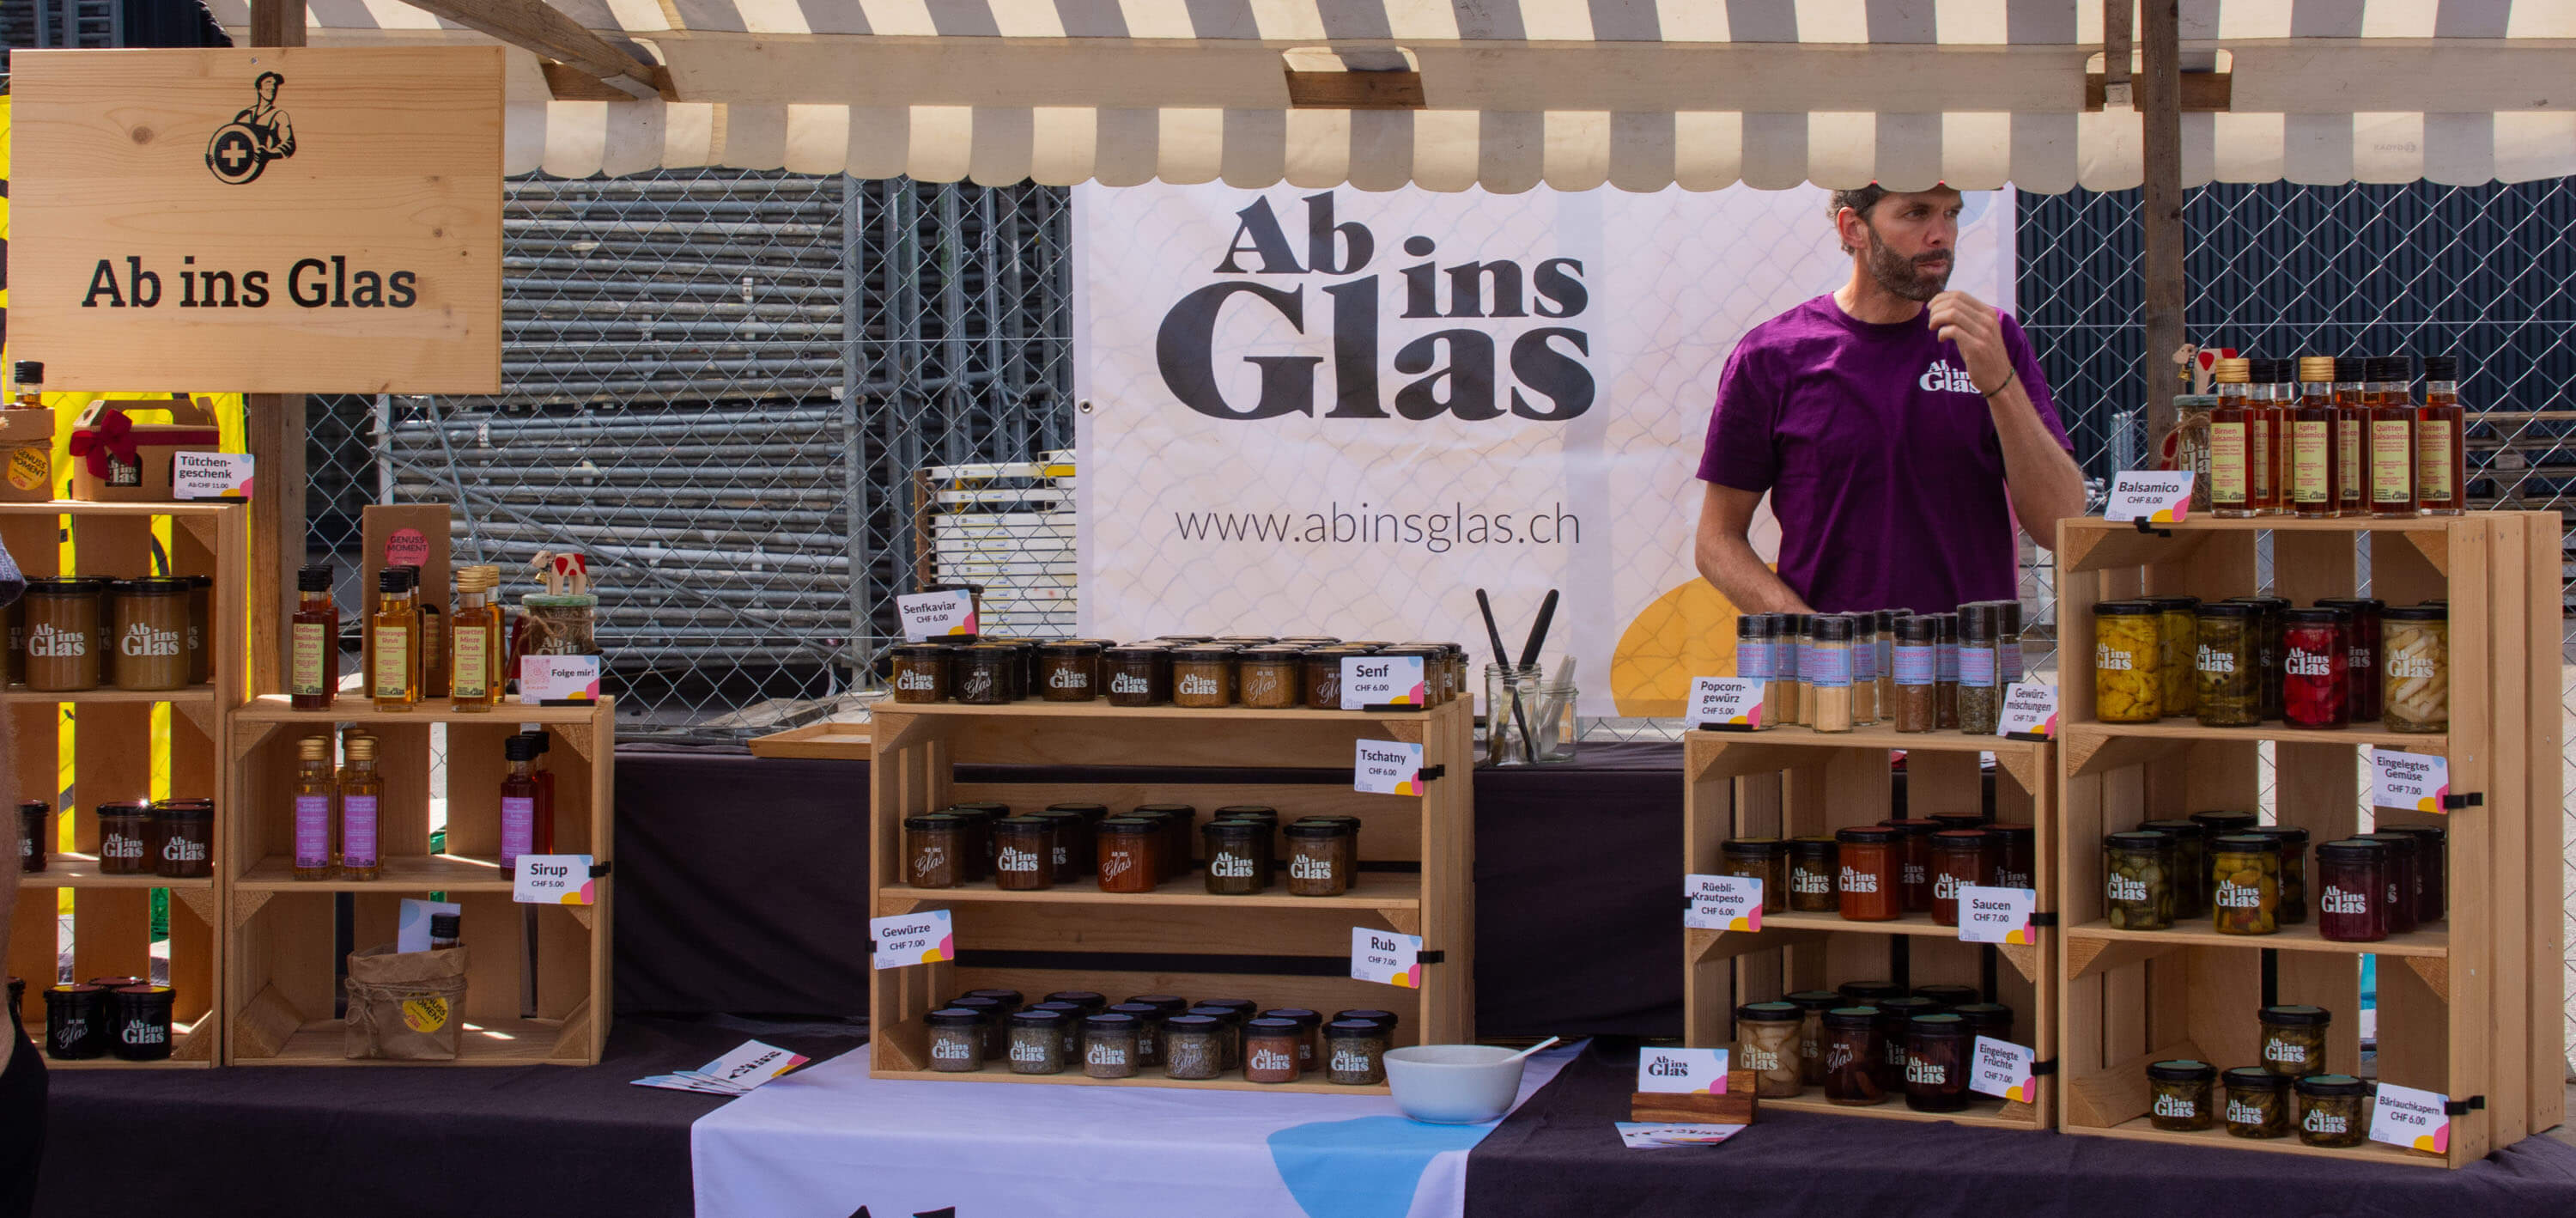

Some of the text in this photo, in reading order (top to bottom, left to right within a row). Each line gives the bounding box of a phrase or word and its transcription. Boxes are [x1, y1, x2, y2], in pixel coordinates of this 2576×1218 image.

[1213, 191, 1589, 318] Ab ins
[82, 254, 417, 308] Ab ins Glas
[1156, 275, 1595, 421] Glas
[1927, 359, 1970, 380] Ab in
[180, 455, 232, 467] Tütchen-
[179, 467, 233, 479] geschenk
[2118, 481, 2179, 494] Balsamico
[1175, 501, 1581, 554] www.abinsglas.ch
[390, 535, 425, 544] GENUSS
[386, 544, 428, 552] MOMENT
[903, 601, 957, 614] Senfkaviar
[916, 615, 932, 624] CHF
[33, 623, 84, 642] Ab ins
[129, 623, 179, 641] Ab ins
[28, 635, 86, 656] Glas
[121, 634, 179, 656] Glas
[2097, 642, 2131, 660] Ab ins
[2095, 652, 2132, 671] Glas
[2289, 647, 2329, 664] Ab ins
[2393, 649, 2433, 667] Ab ins
[551, 668, 595, 679] Folge mir!
[1054, 667, 1087, 680] Ab ins
[1356, 664, 1388, 678] Senf
[2285, 657, 2330, 676] Glas
[2388, 659, 2434, 678] Glas
[1049, 674, 1087, 689] Glas
[1185, 673, 1217, 686] Ab ins
[1179, 680, 1218, 695] Glas
[1701, 681, 1746, 694] Popcorn-
[2015, 688, 2047, 698] Gewürz-
[1704, 693, 1740, 705] gewürz
[2007, 699, 2052, 713] mischungen
[1360, 749, 1406, 765] Tschatny
[2377, 756, 2431, 773] Eingelegtes
[2385, 769, 2423, 783] Gemüse
[2387, 783, 2421, 795] CHF 7.00
[106, 833, 143, 847] Ab ins
[102, 843, 144, 858] Glas
[1000, 846, 1037, 861] Ab ins
[998, 855, 1038, 871] Glas
[1216, 852, 1254, 867] Ab ins
[1294, 853, 1331, 868] Ab ins
[530, 862, 568, 877] Sirup
[1211, 861, 1254, 878] Glas
[1290, 862, 1332, 880] Glas
[1794, 867, 1829, 883] Ab ins
[1841, 865, 1876, 883] Ab ins
[1702, 882, 1735, 893] Rüebli-
[1790, 877, 1829, 894] Glas
[1838, 875, 1878, 893] Glas
[2219, 880, 2258, 896] Ab ins
[1692, 892, 1744, 904] Krautpesto
[2215, 889, 2260, 908] Glas
[2324, 886, 2365, 902] Ab ins
[1701, 906, 1716, 915] CHF
[1972, 898, 2010, 910] Saucen
[2321, 894, 2366, 914] Glas
[1973, 913, 2008, 923] CHF 7.00
[882, 923, 931, 938] Gewürze
[890, 940, 926, 951] CHF 7.00
[1371, 936, 1396, 952] Rub
[1368, 955, 1397, 966] CHF 7.00
[127, 1020, 165, 1033] Ab ins
[122, 1028, 165, 1044] Glas
[1012, 1040, 1044, 1053] Ab ins
[1743, 1044, 1777, 1060] Ab ins
[1979, 1043, 2019, 1062] Eingelegte
[2269, 1038, 2305, 1052] Ab ins
[1010, 1047, 1045, 1062] Glas
[1257, 1049, 1271, 1058] Ab
[2265, 1045, 2305, 1063] Glas
[1251, 1057, 1291, 1070] Glas
[1655, 1056, 1688, 1068] Ab ins
[1740, 1054, 1779, 1070] Glas
[1908, 1057, 1944, 1074] Ab ins
[1984, 1055, 2013, 1070] Früchte
[1648, 1063, 1689, 1078] Glas
[1905, 1067, 1946, 1085] Glas
[1984, 1071, 2013, 1083] CHF 7.00
[2160, 1093, 2193, 1109] Ab ins
[2379, 1094, 2440, 1117] Bärlauchkapern
[2154, 1100, 2195, 1118] Glas
[2309, 1109, 2346, 1124] Ab ins
[2304, 1117, 2348, 1134] Glas
[2391, 1111, 2426, 1126] CHF 6.00
